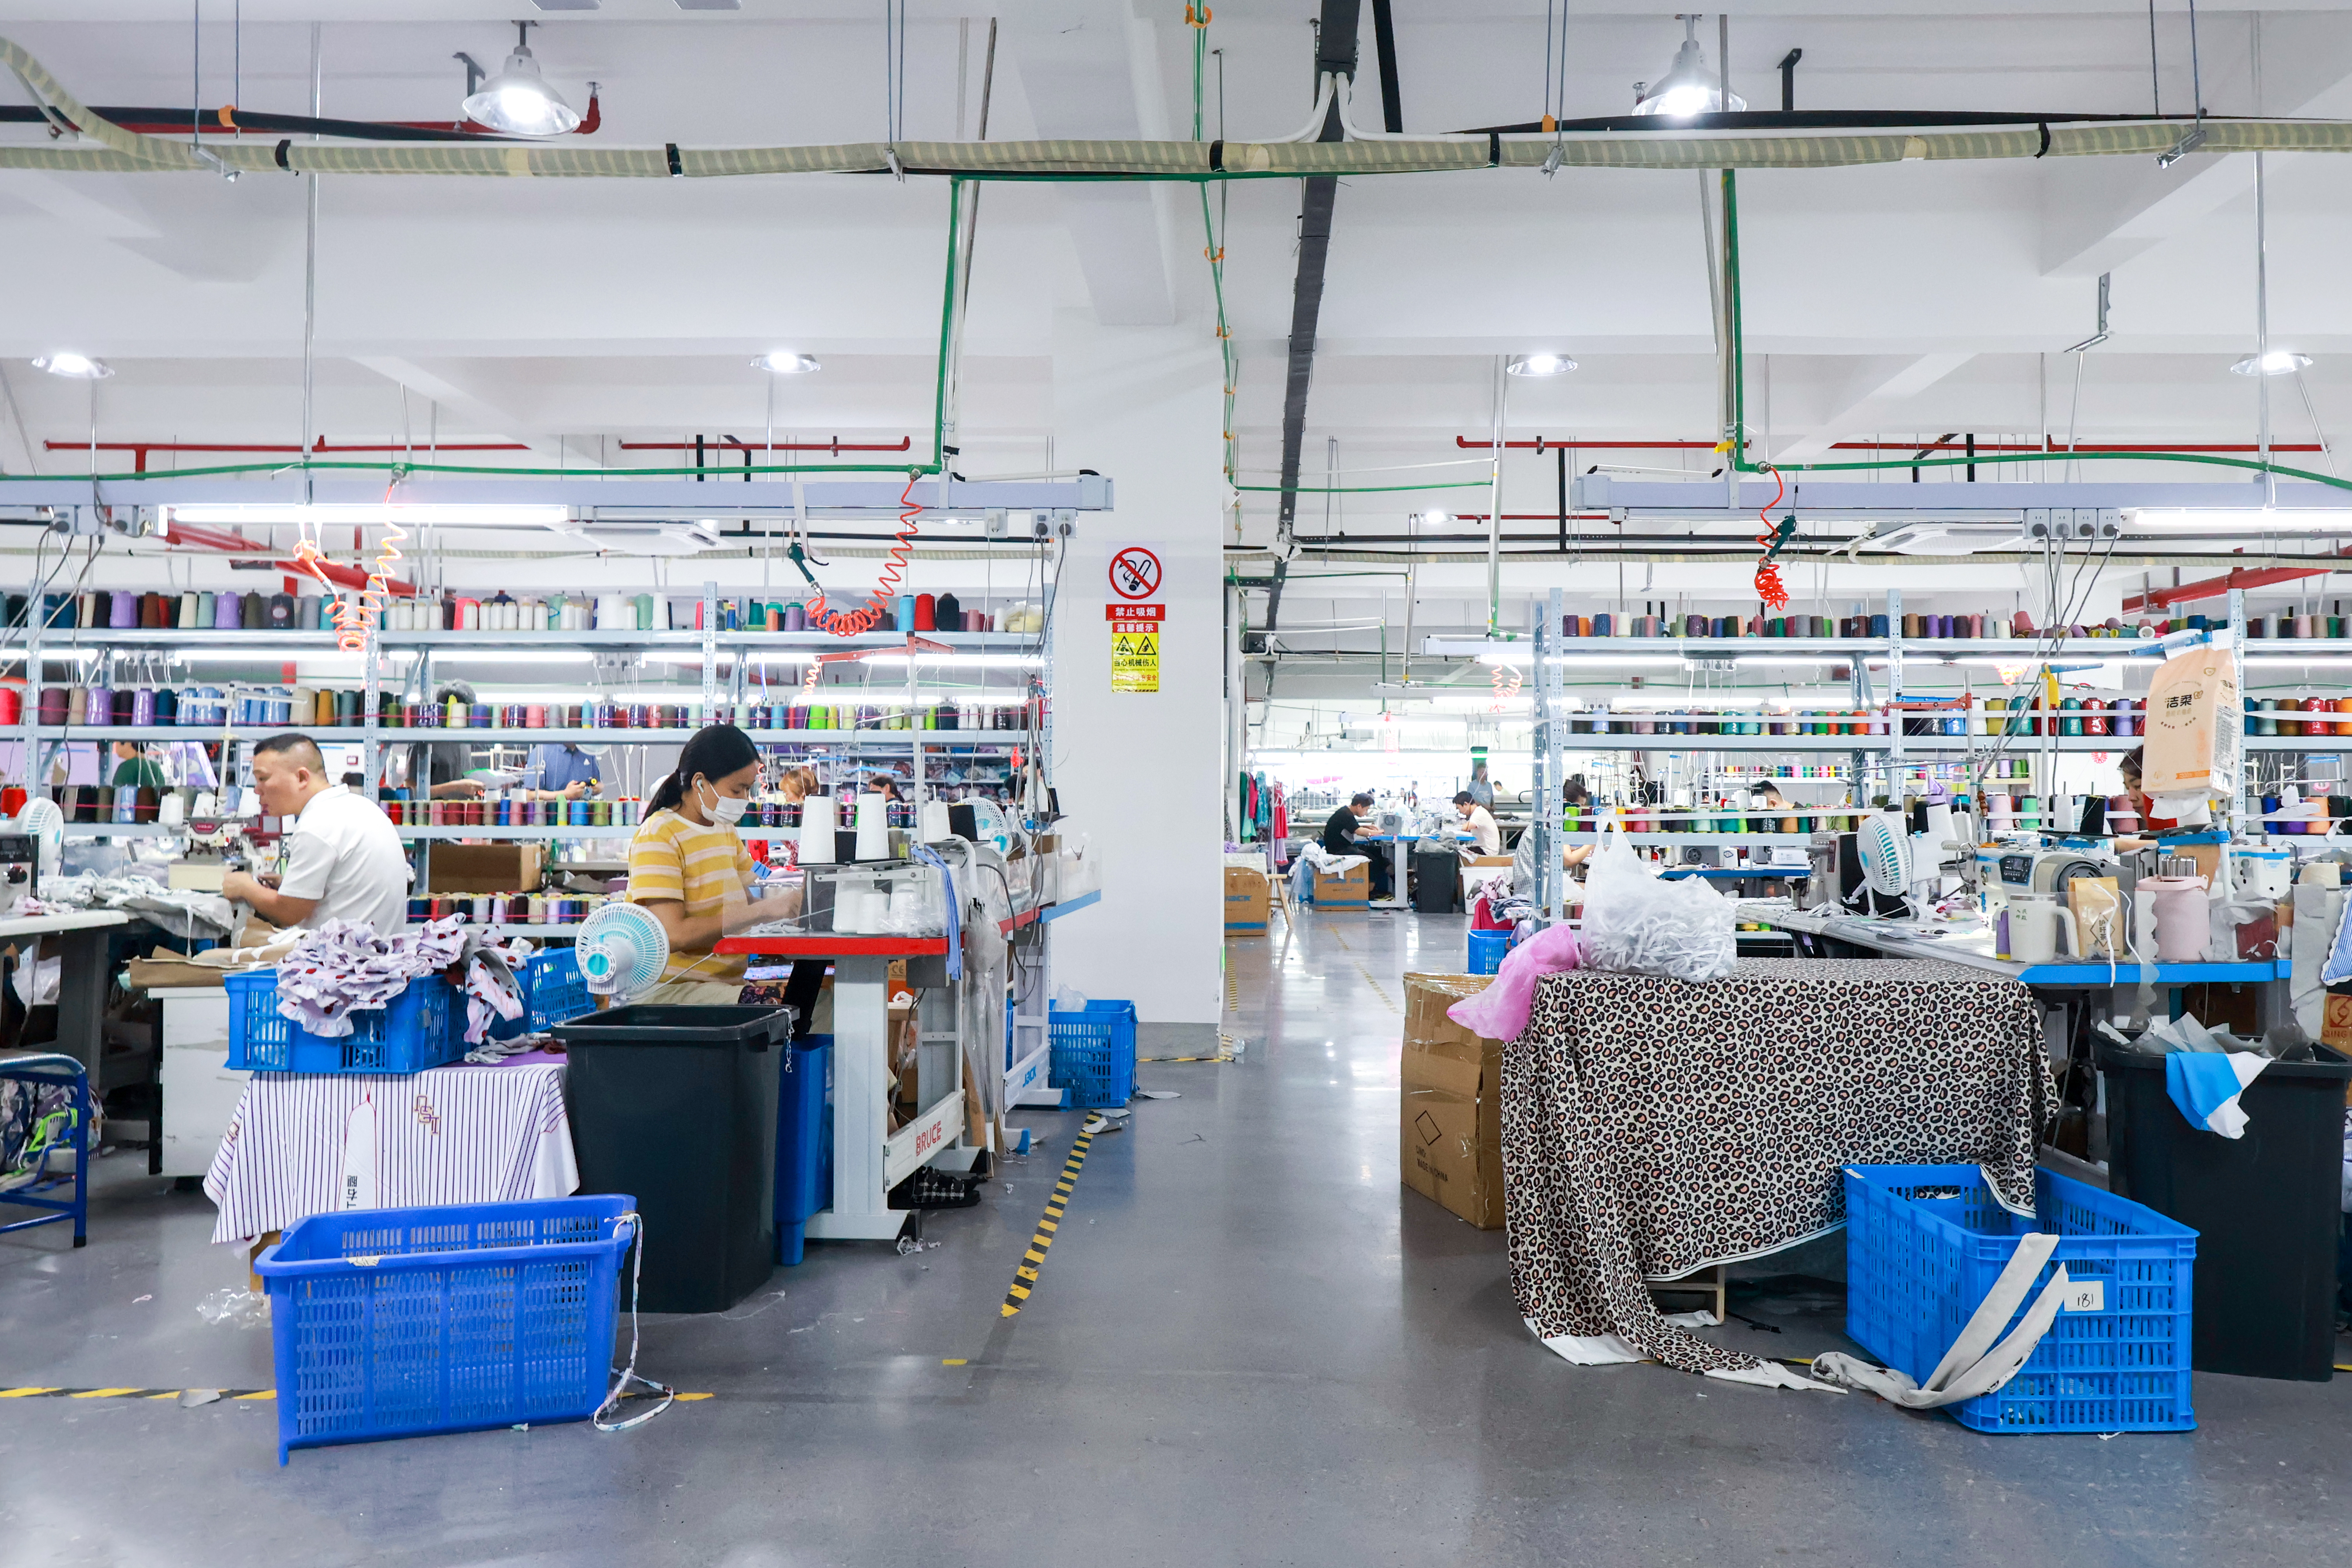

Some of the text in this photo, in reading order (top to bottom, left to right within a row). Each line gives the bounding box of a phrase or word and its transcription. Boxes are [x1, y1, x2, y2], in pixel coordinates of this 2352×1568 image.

[1115, 607, 1156, 616] 禁止吸烟
[1117, 623, 1154, 632] 温馨提示
[1114, 659, 1156, 667] 当心机械伤人
[2165, 694, 2192, 708] 洁柔
[1023, 1065, 1036, 1087] JACK
[916, 1121, 941, 1156] BRUCE
